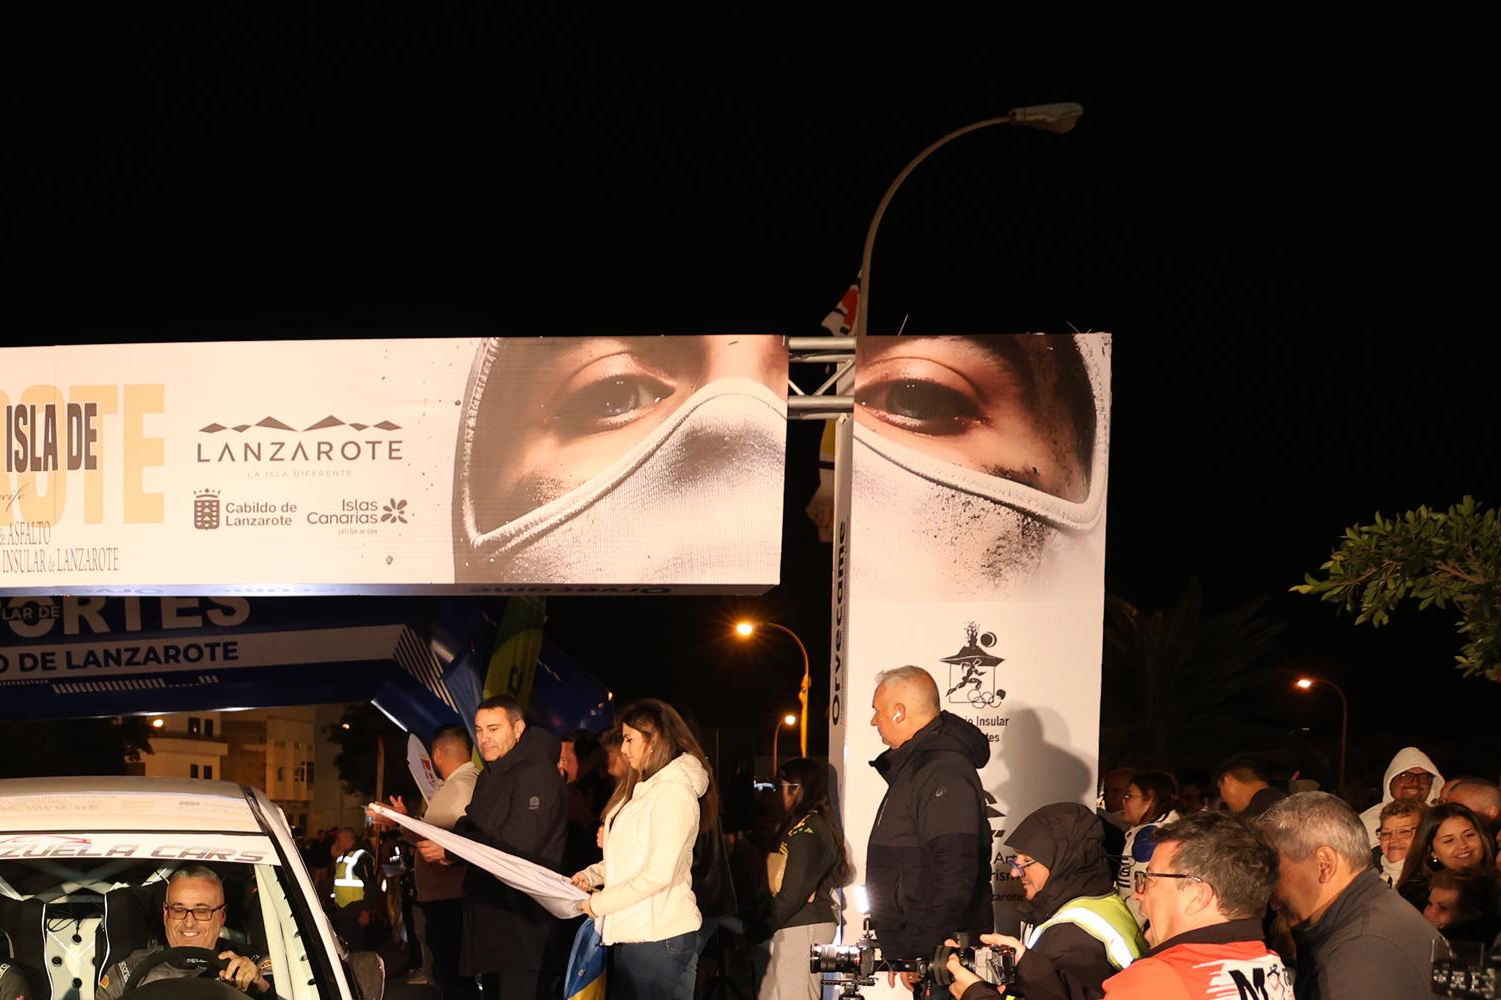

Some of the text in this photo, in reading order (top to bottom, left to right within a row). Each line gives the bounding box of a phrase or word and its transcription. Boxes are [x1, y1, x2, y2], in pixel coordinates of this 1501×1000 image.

[6, 403, 58, 473] ISLA
[66, 402, 98, 471] DE
[197, 440, 403, 462] LANZAROTE
[265, 470, 288, 478] ISLA
[293, 469, 352, 478] DIFERENTE
[225, 501, 298, 514] Cabildo de
[342, 498, 379, 512] Islas
[225, 515, 293, 527] Lanzarote
[306, 511, 379, 525] Canarias
[7, 521, 52, 545] ASFALTO
[2, 547, 47, 573] INSULAR
[57, 546, 120, 572] LANZAROTE
[38, 605, 61, 619] DE
[831, 519, 846, 726] Orvecame
[18, 651, 56, 673] DE
[65, 641, 240, 670] LANZAROTE
[976, 715, 1009, 727] Insular
[150, 844, 270, 865] CARS
